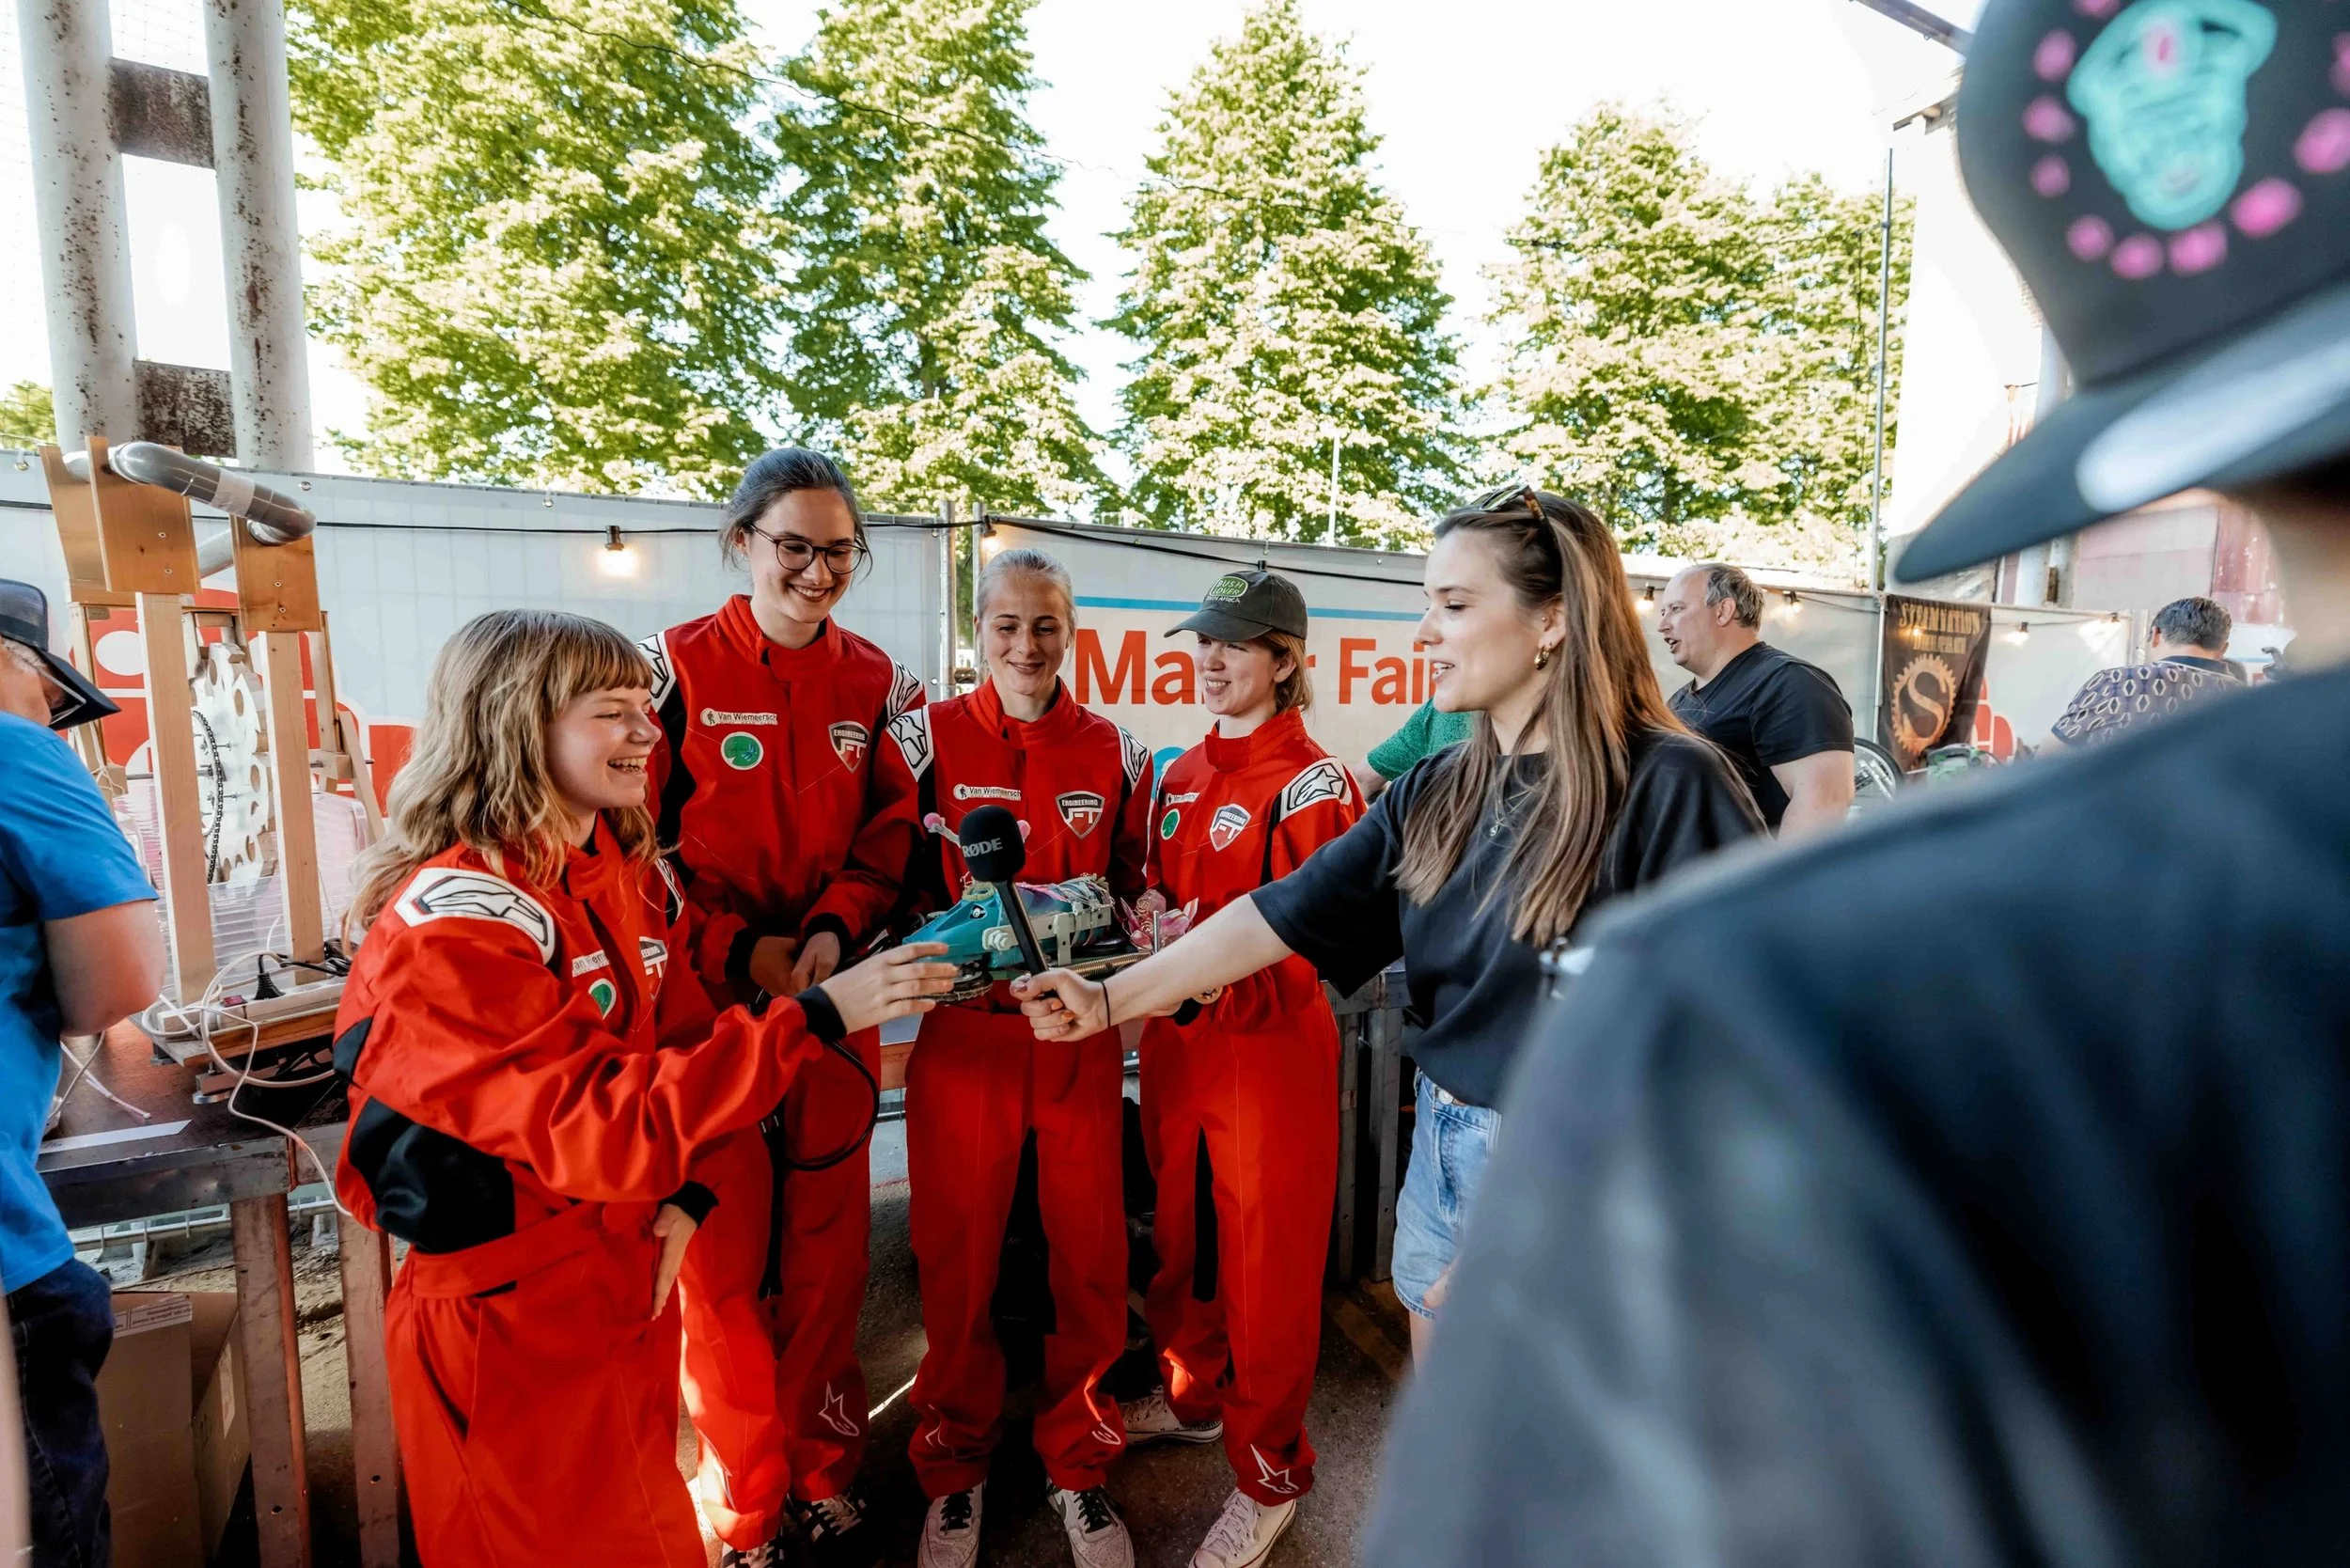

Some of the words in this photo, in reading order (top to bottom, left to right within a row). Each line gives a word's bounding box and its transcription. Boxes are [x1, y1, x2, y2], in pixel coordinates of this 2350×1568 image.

[1216, 580, 1245, 588] BUSH
[717, 712, 732, 721] Van
[969, 787, 982, 795] Van
[1061, 798, 1099, 807] ENGINEERING
[962, 837, 1004, 858] RØDE
[573, 959, 586, 969] an
